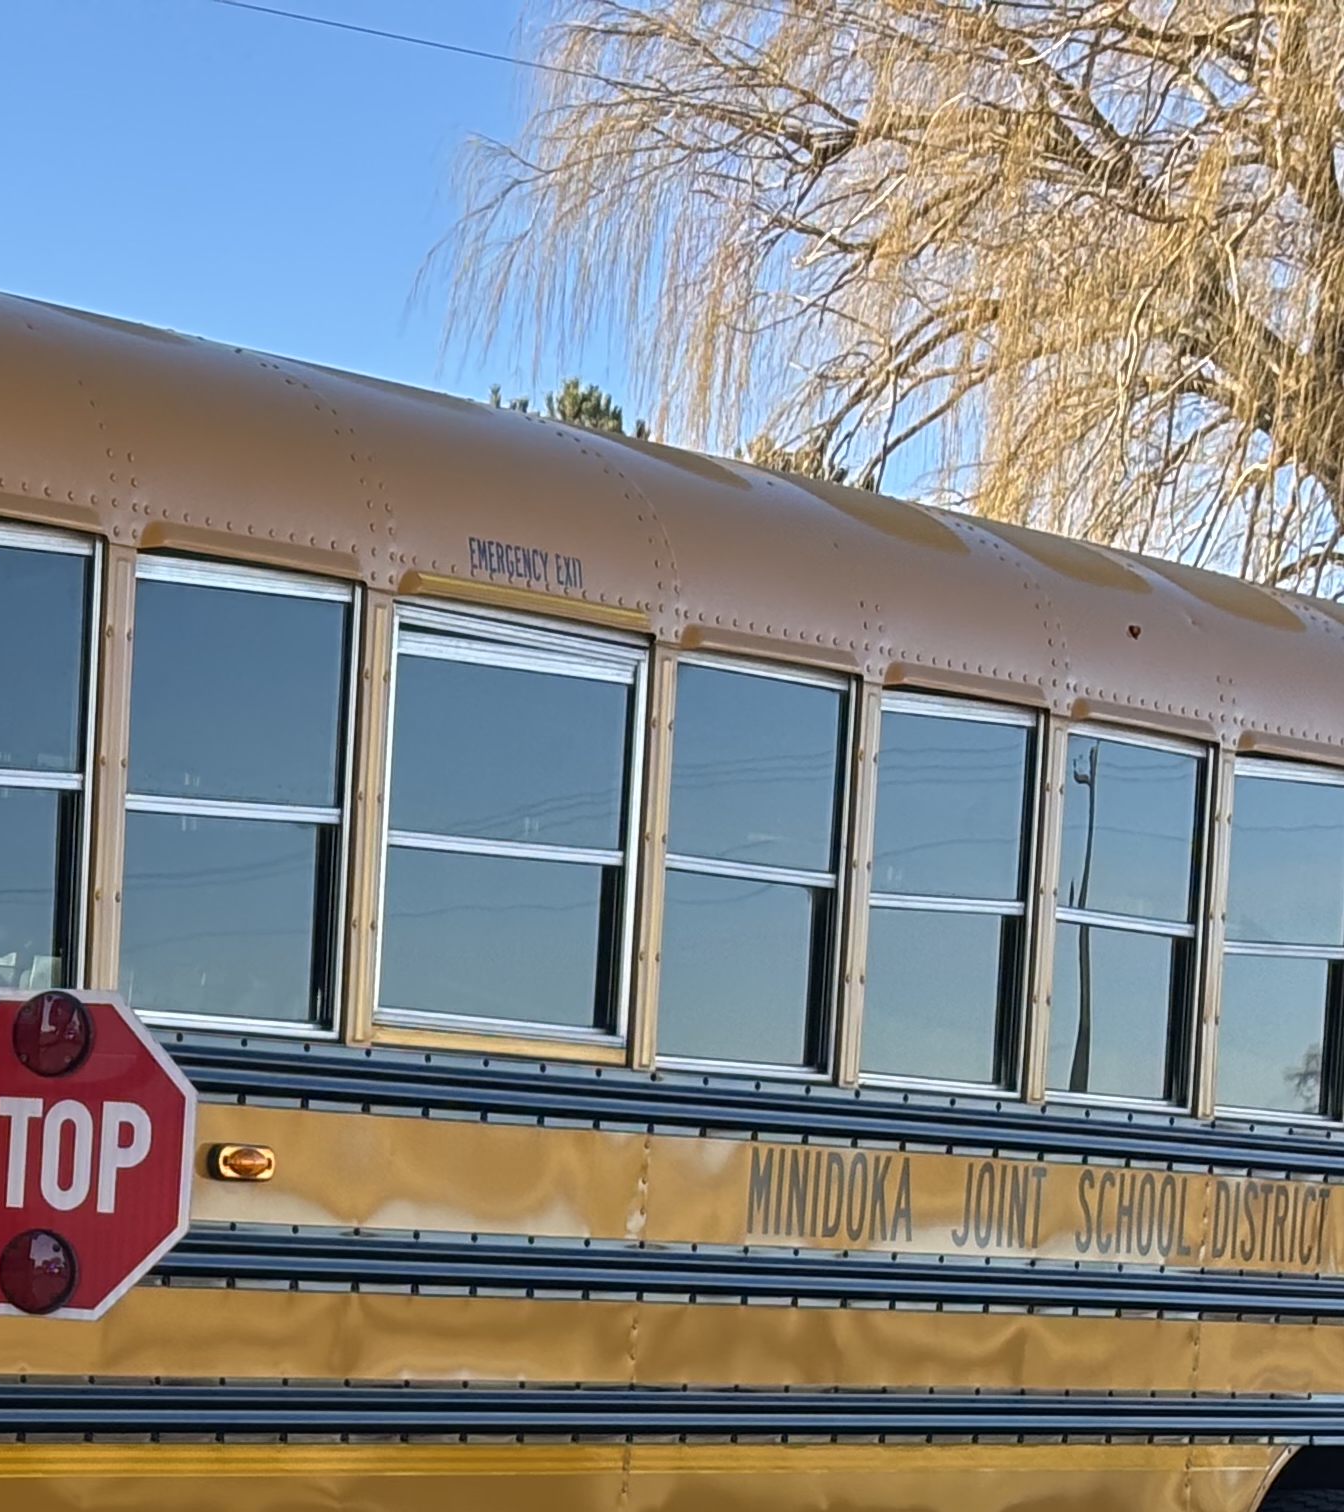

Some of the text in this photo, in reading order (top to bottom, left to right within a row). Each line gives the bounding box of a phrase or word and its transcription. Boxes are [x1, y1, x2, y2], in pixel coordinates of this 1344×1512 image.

[468, 536, 583, 589] EMERGENCY EXIT
[746, 1146, 1332, 1266] MINIDOKA JOINT SCHOOL DISTRICT
